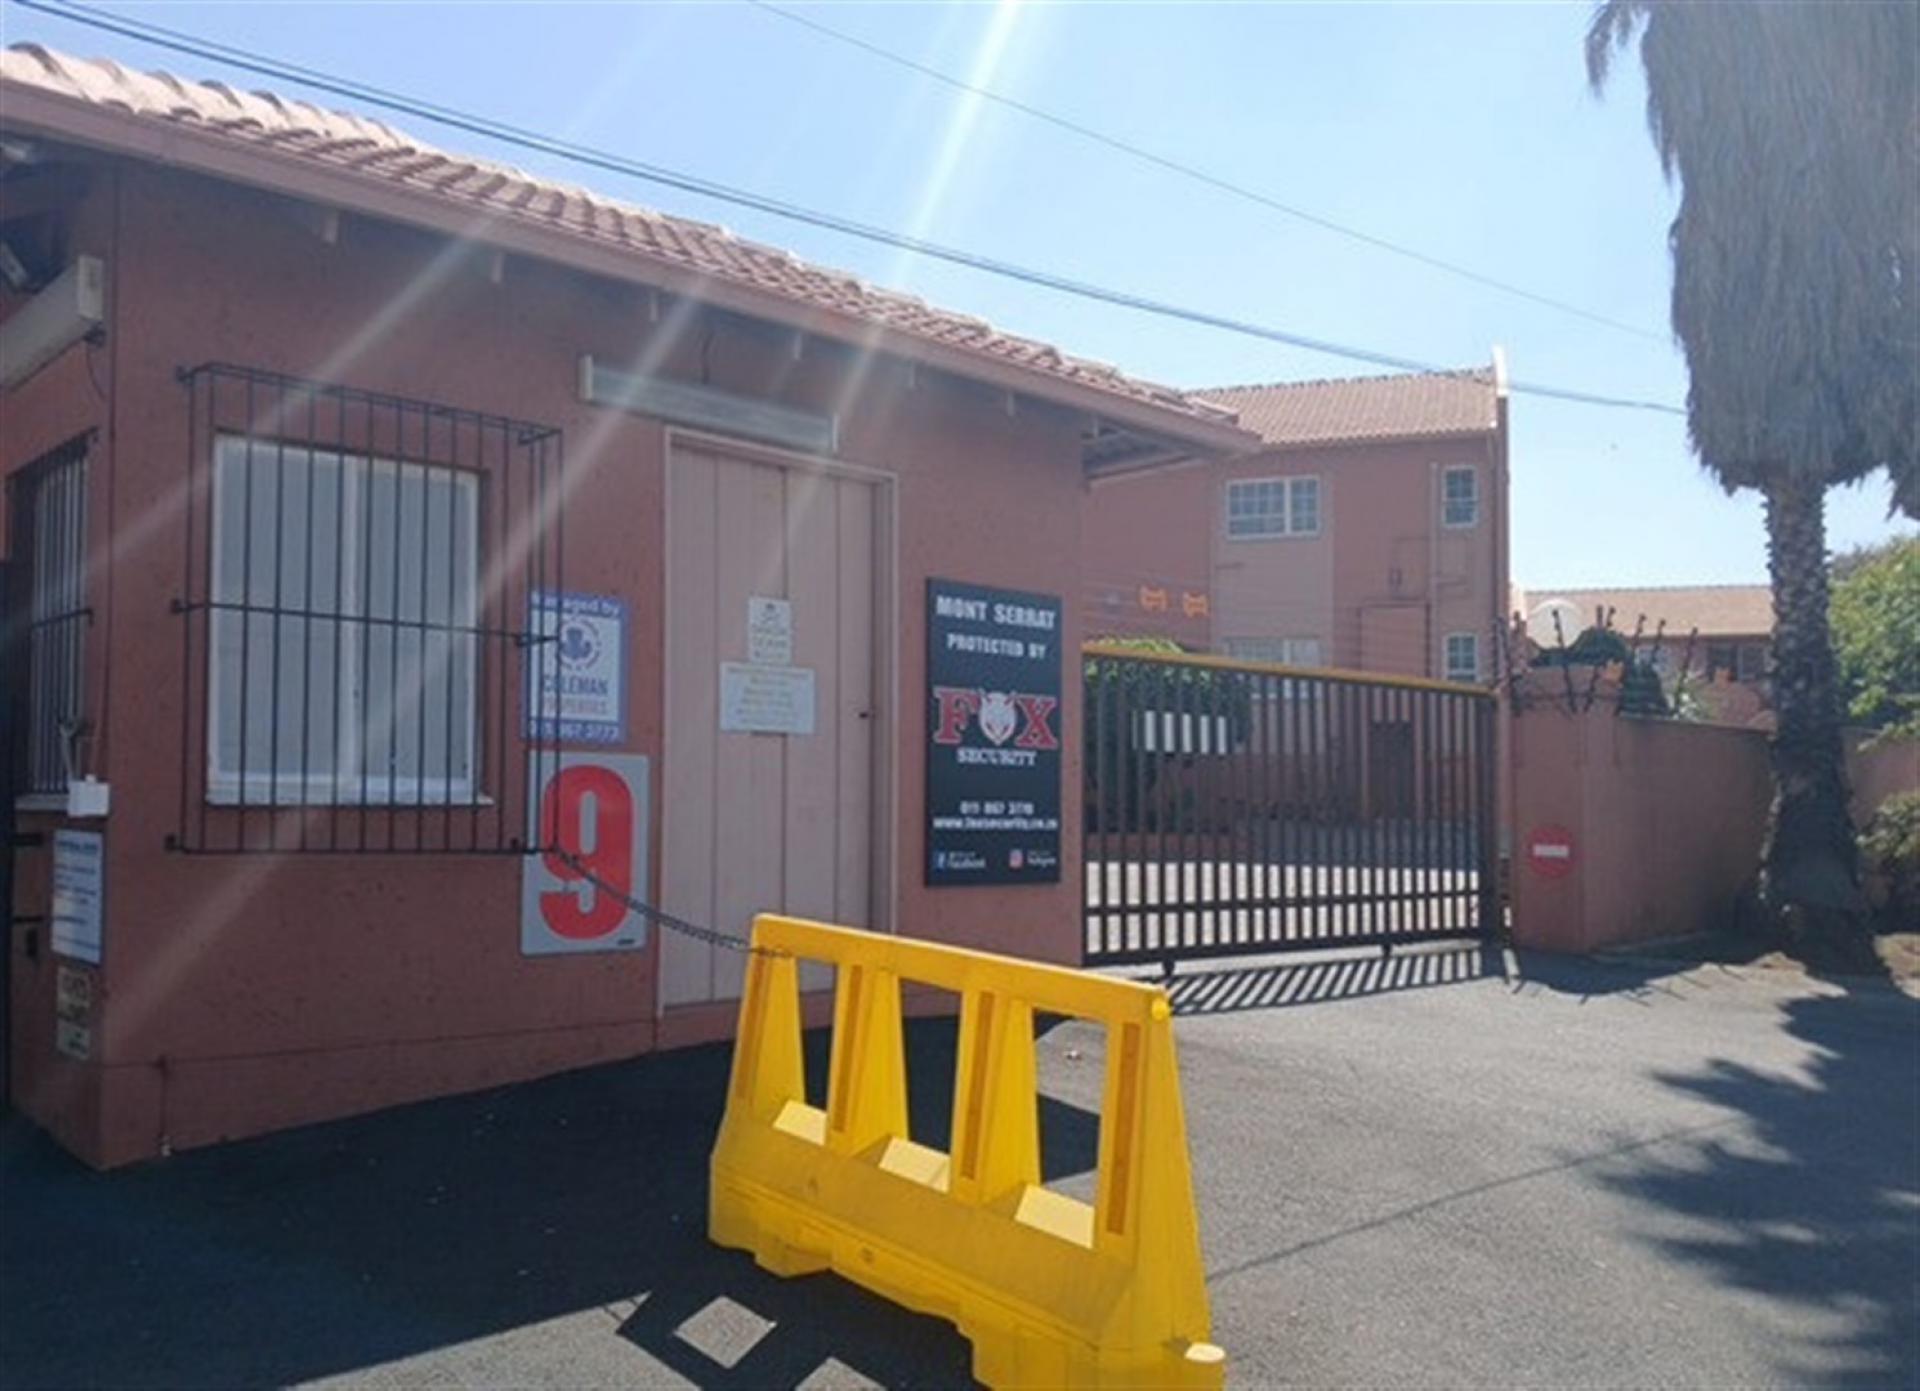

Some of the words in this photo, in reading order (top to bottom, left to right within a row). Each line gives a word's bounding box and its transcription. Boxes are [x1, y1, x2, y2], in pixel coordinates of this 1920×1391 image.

[936, 595, 987, 622] MONT
[993, 602, 1056, 630] SERRAT
[947, 633, 1024, 658] PROTECTED
[1029, 642, 1047, 660] BY
[956, 747, 1038, 767] SECURITY
[538, 764, 634, 941] 9
